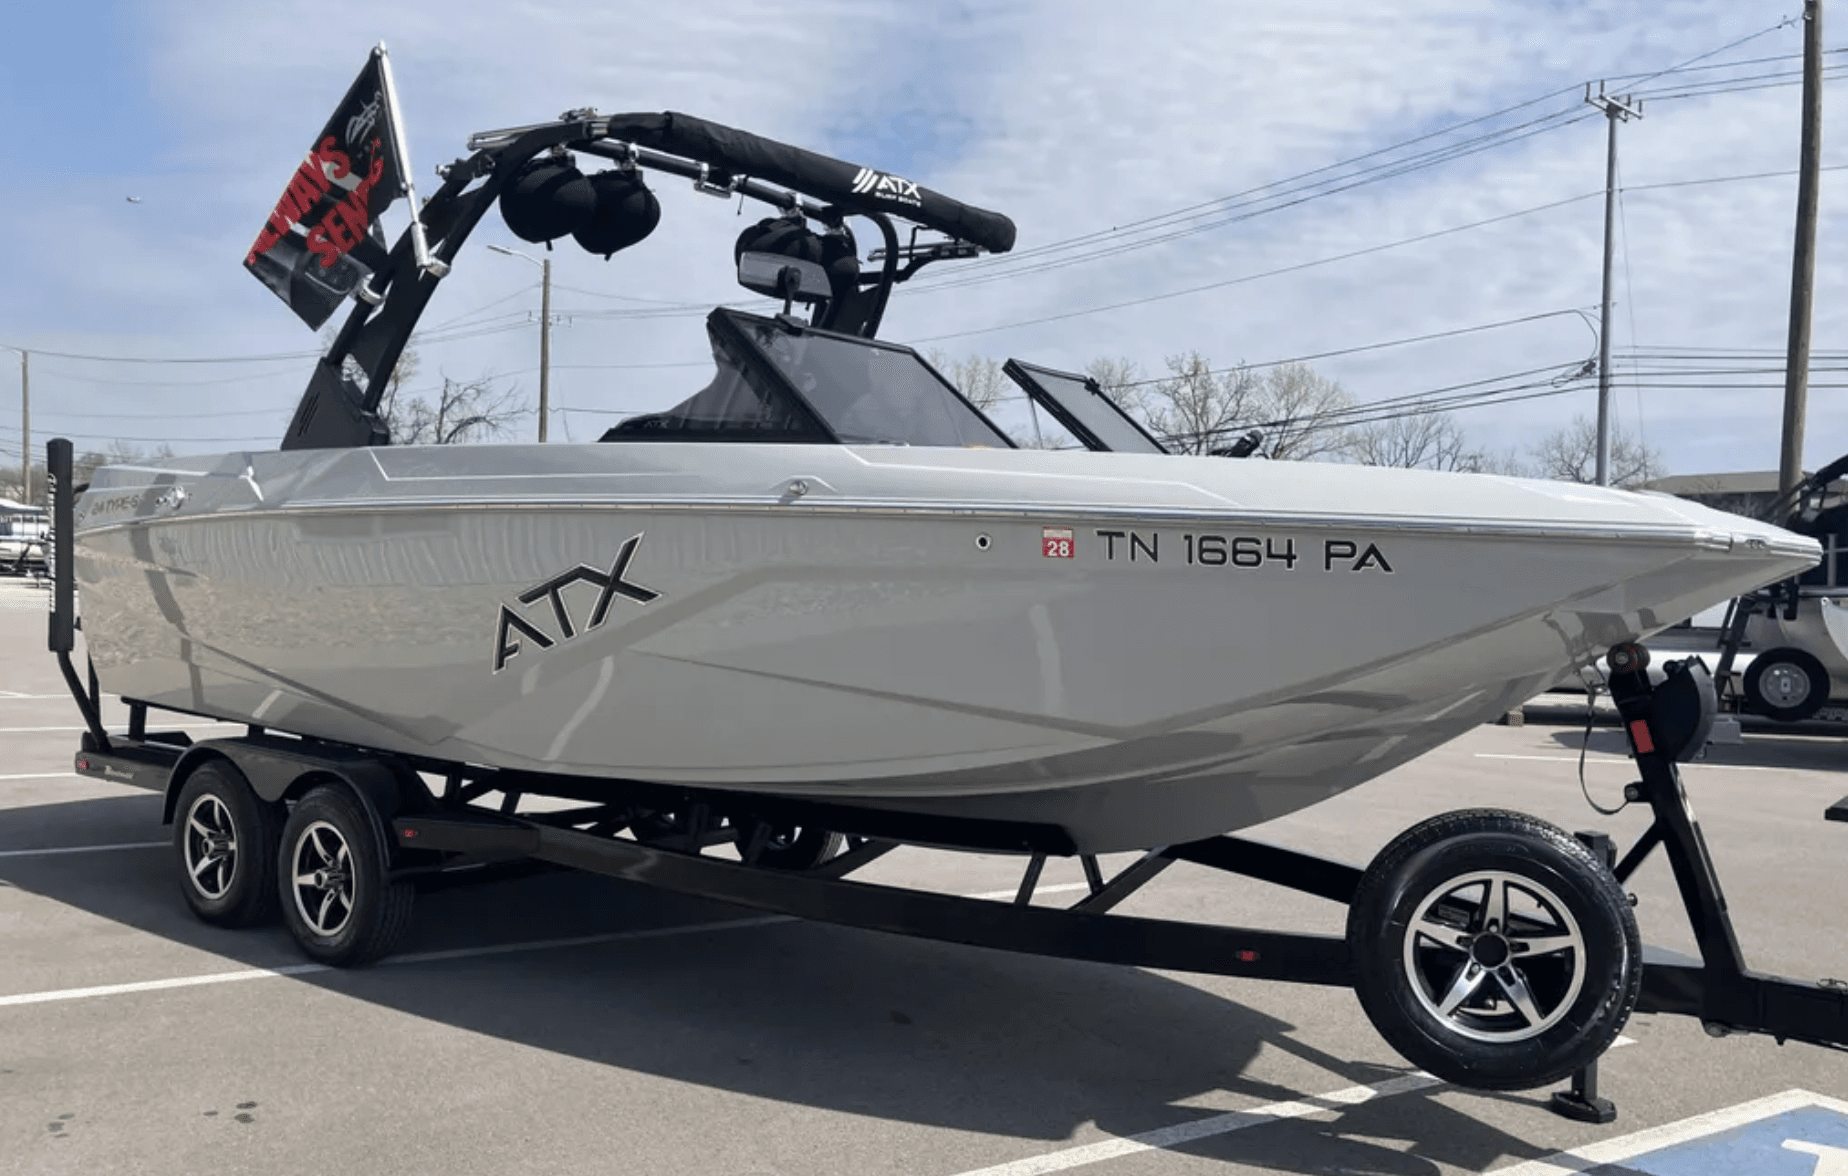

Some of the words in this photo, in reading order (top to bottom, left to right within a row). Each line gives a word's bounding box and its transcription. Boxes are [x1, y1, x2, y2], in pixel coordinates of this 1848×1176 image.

[876, 174, 922, 199] ATX
[1048, 541, 1069, 556] 28
[1095, 529, 1159, 563] TN
[1183, 534, 1297, 570] 1664
[1323, 539, 1394, 572] PA
[493, 531, 663, 675] ATX
